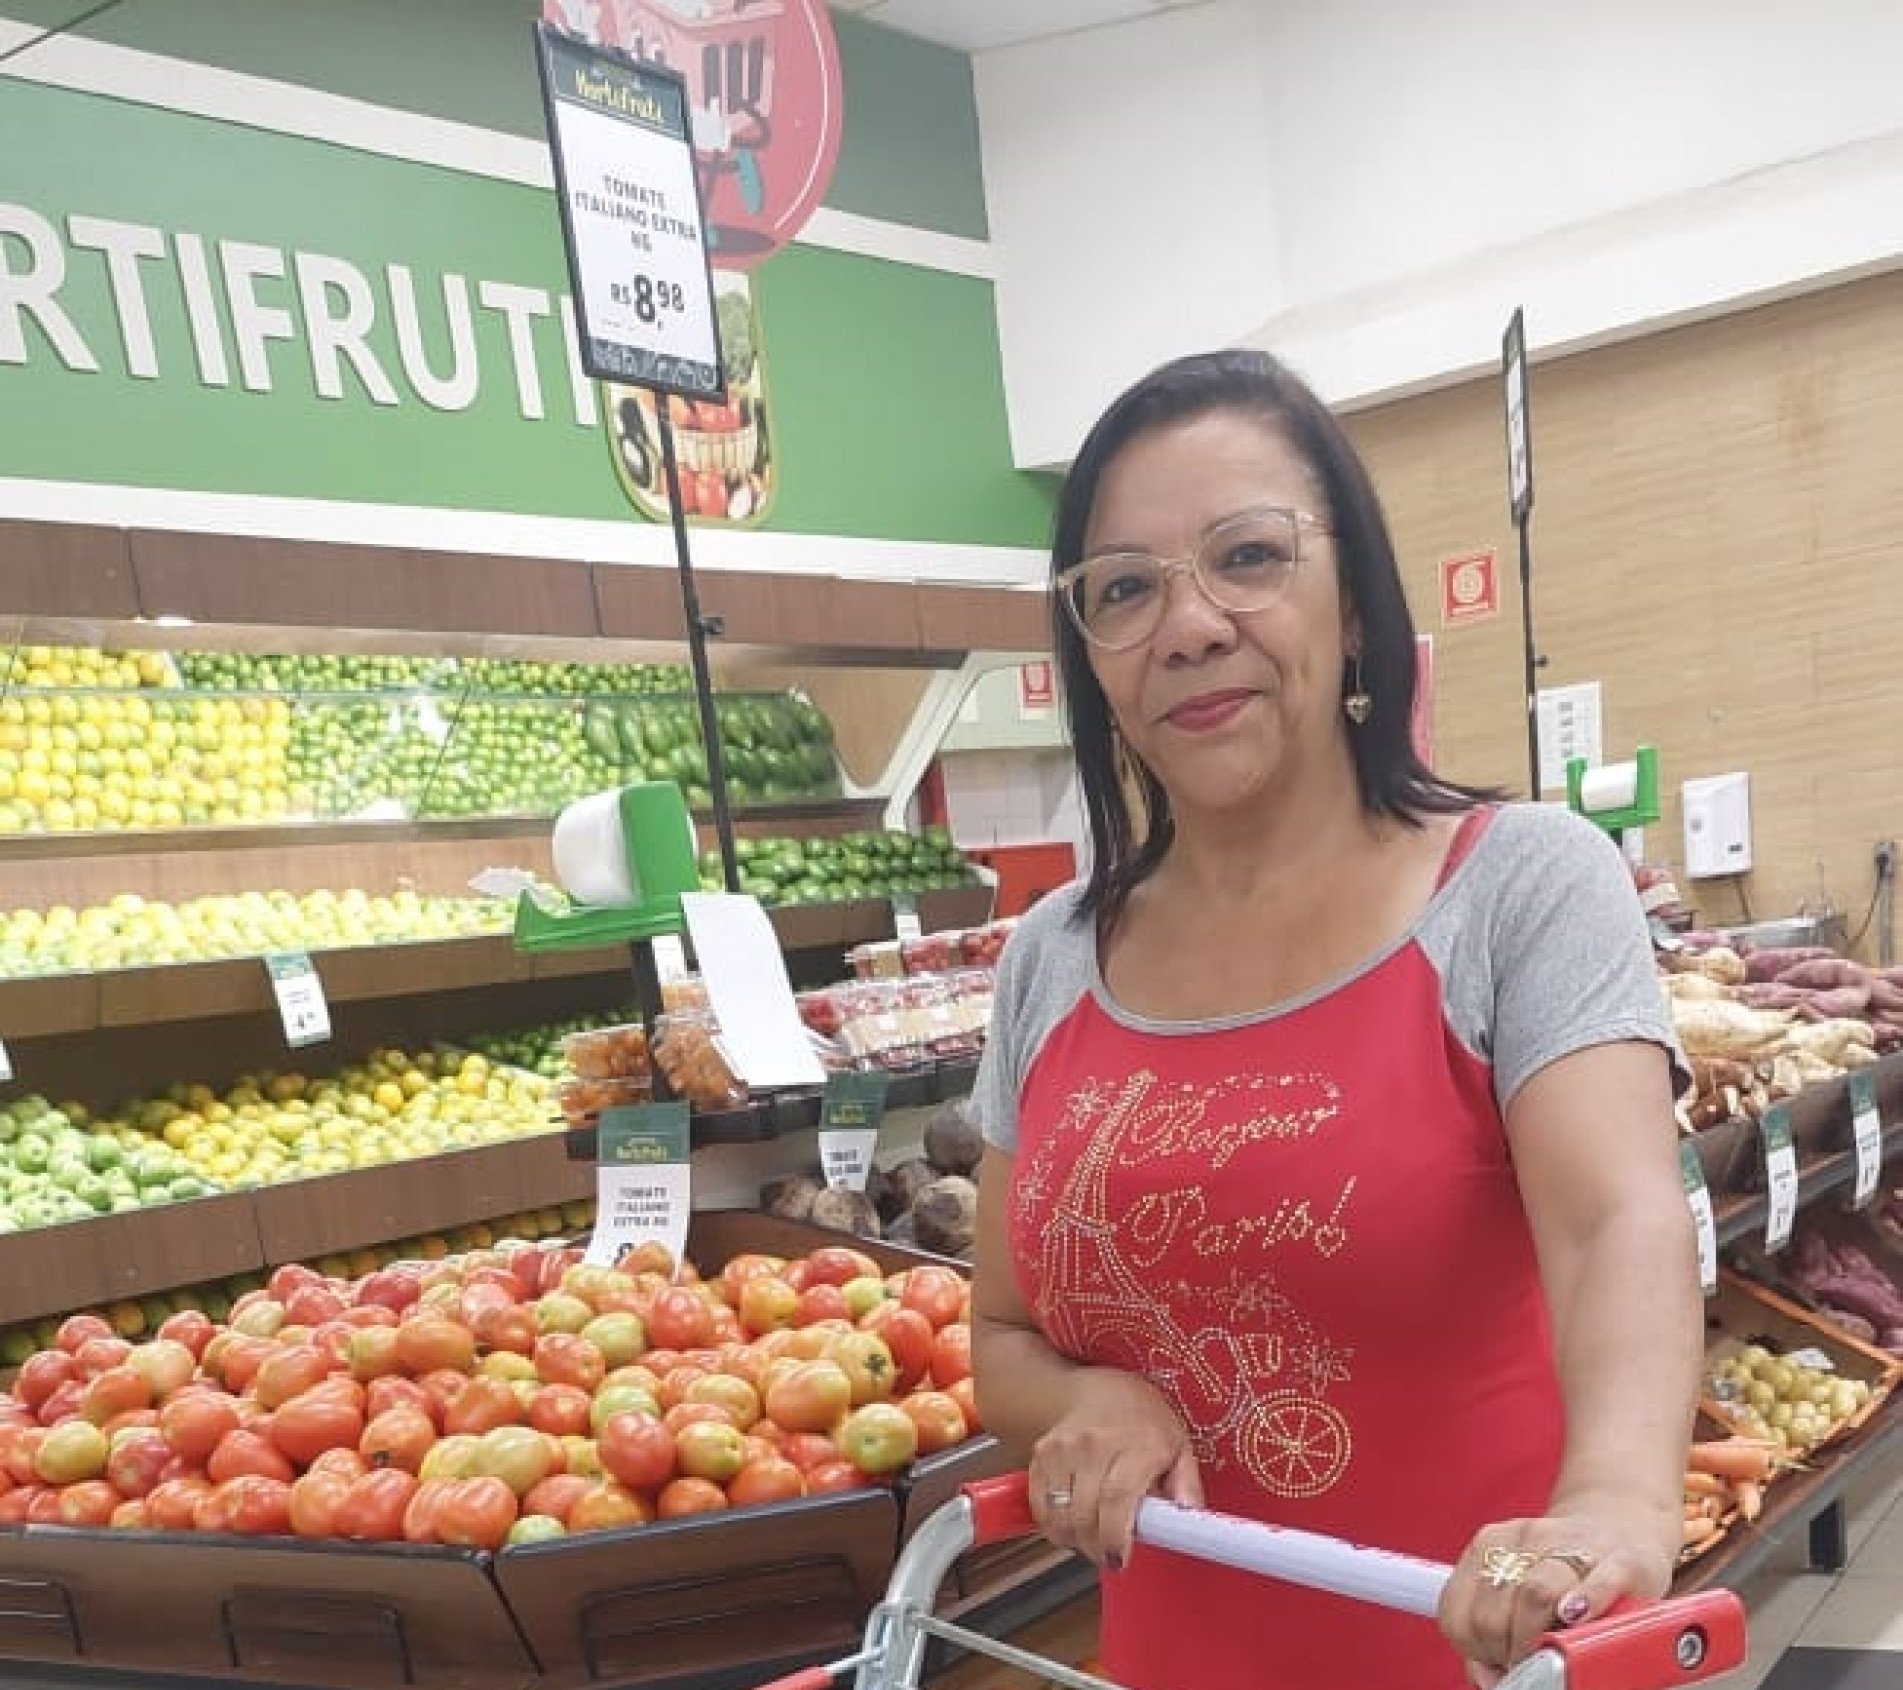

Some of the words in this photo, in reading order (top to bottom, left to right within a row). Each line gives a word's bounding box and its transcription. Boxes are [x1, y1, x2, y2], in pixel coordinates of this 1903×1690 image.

[603, 174, 667, 211] TOMATE
[575, 191, 648, 228] ITALIANO
[651, 212, 697, 241] EXTRA
